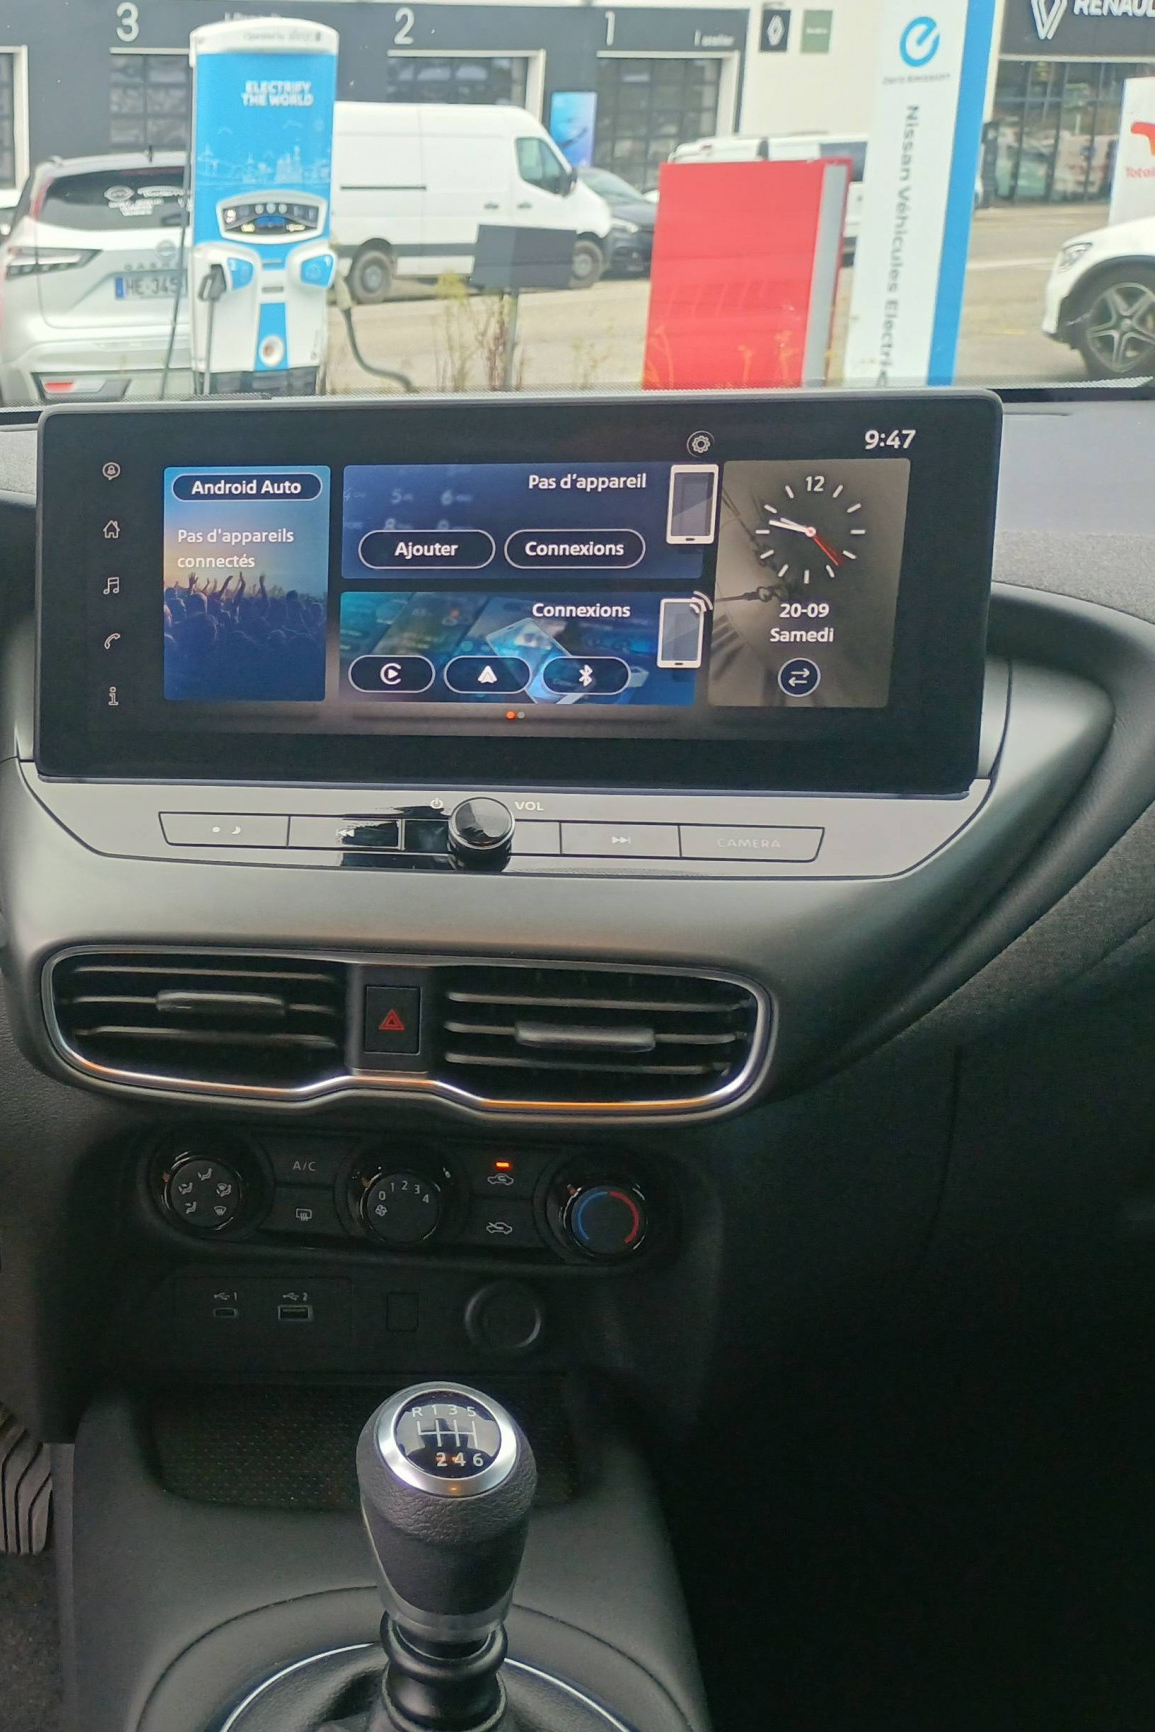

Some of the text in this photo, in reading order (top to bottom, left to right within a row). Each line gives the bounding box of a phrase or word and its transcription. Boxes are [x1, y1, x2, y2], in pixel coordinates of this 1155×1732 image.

[116, 2, 139, 42] 3
[394, 8, 415, 45] 2
[605, 11, 616, 46] 1
[245, 80, 313, 93] ELECTRIFY
[241, 93, 314, 107] THE WORLD
[898, 104, 919, 181] Nissan
[865, 429, 916, 449] 9:47
[192, 480, 302, 495] Android Auto
[528, 472, 647, 493] Pas d'appareil
[805, 475, 826, 493] 12
[178, 527, 295, 546] Pas d'appareils
[394, 541, 459, 560] Ajouter
[524, 542, 624, 557] Connexions
[177, 553, 256, 569] connectés
[531, 602, 631, 618] Connexions
[778, 603, 830, 619] 20-09
[769, 626, 835, 643] Samedi
[514, 800, 544, 811] VOL
[717, 837, 782, 849] CAMERA
[292, 1160, 317, 1172] A/C
[378, 1180, 429, 1203] 0 1 2 3 4
[412, 1404, 477, 1417] R 1 3 5
[436, 1452, 484, 1467] 2 4 6
